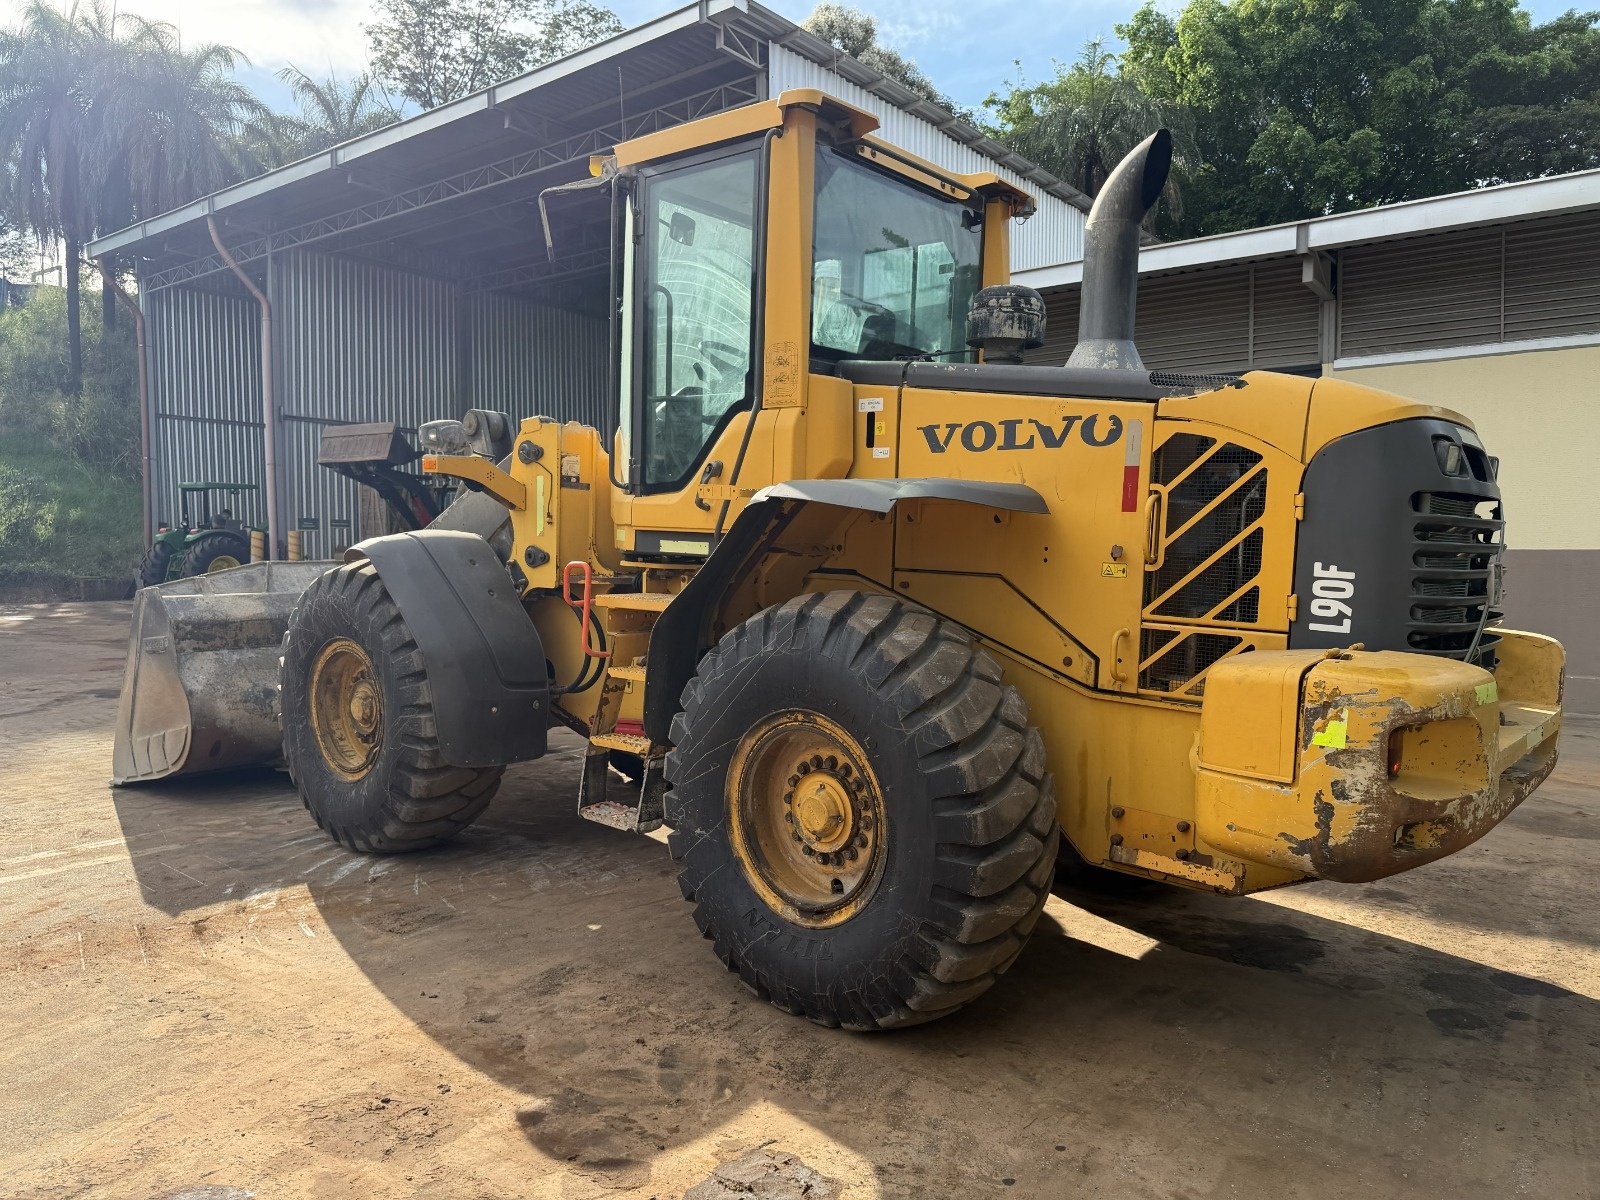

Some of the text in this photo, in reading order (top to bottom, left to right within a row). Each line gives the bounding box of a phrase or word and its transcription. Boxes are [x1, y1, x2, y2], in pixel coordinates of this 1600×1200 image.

[917, 414, 1123, 453] VOLVO
[1309, 562, 1355, 633] L90F
[742, 908, 834, 961] TITAN
